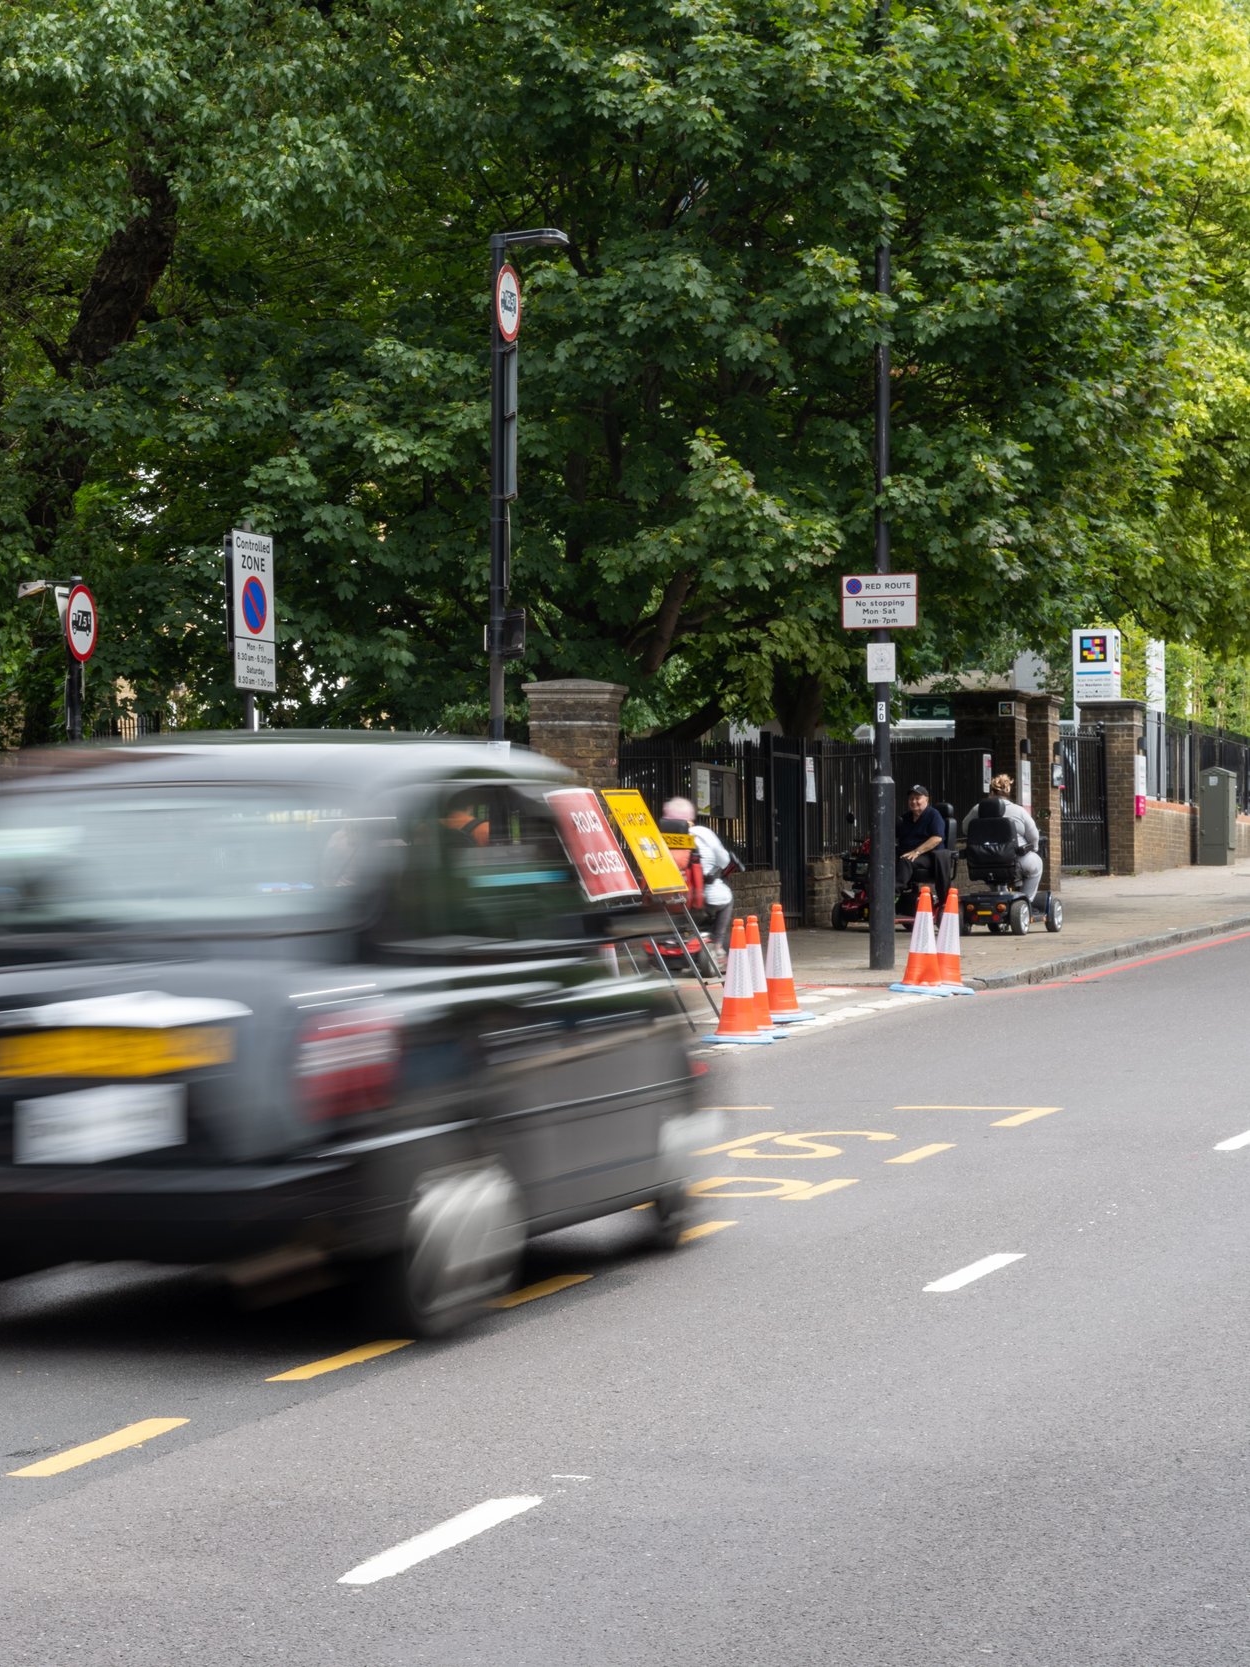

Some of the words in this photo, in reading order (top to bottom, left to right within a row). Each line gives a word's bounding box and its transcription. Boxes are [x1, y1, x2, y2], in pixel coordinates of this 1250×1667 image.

[235, 536, 271, 554] Controlled
[241, 554, 266, 573] ZONE
[865, 582, 881, 590] RED
[884, 582, 911, 590] ROUTE
[870, 599, 905, 607] stopping
[882, 607, 896, 615] Sat
[881, 617, 898, 625] 7pm
[570, 810, 604, 834] ROAD
[584, 849, 626, 876] CLOSED
